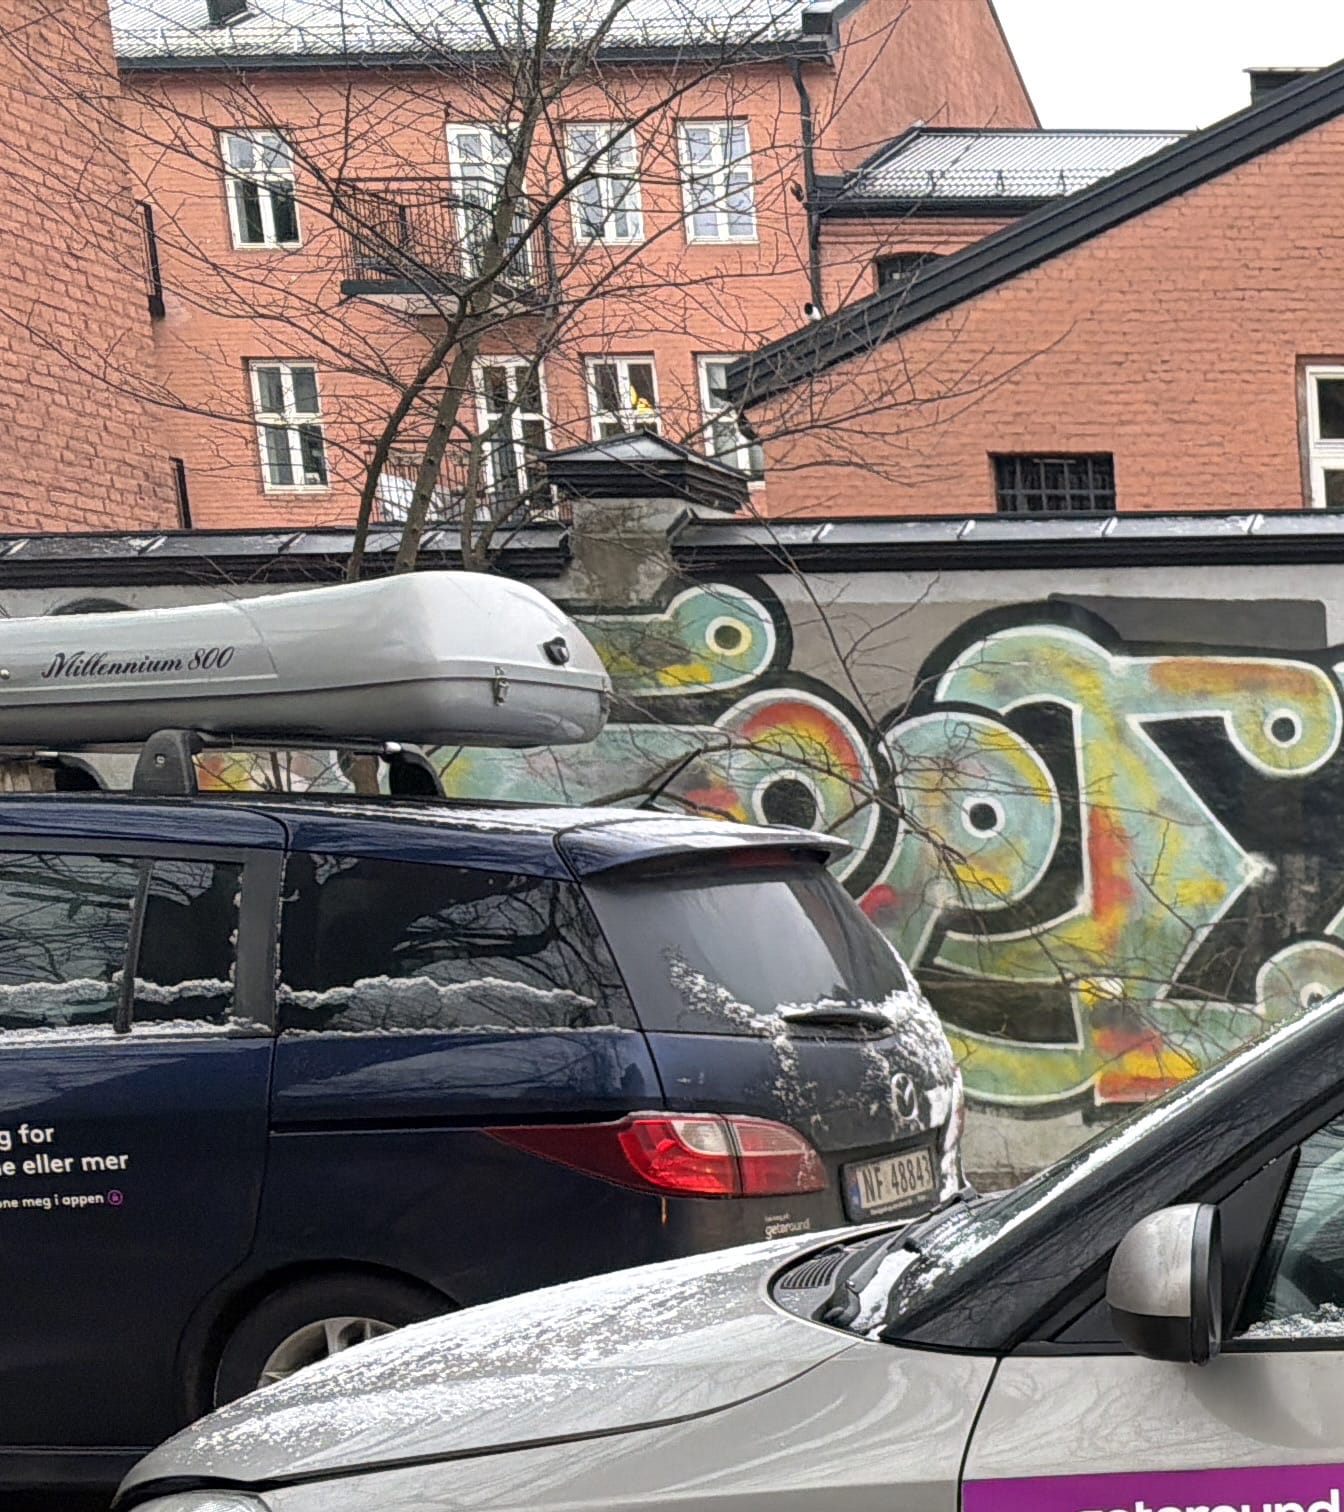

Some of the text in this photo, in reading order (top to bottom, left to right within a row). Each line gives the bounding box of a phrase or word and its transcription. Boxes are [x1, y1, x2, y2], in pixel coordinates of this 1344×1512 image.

[41, 646, 235, 679] Millennium 800
[18, 1123, 55, 1143] for
[0, 1153, 129, 1176] e eller mer
[862, 1166, 883, 1204] NF
[22, 1197, 52, 1210] meg
[54, 1193, 60, 1206] i
[62, 1194, 105, 1209] appen
